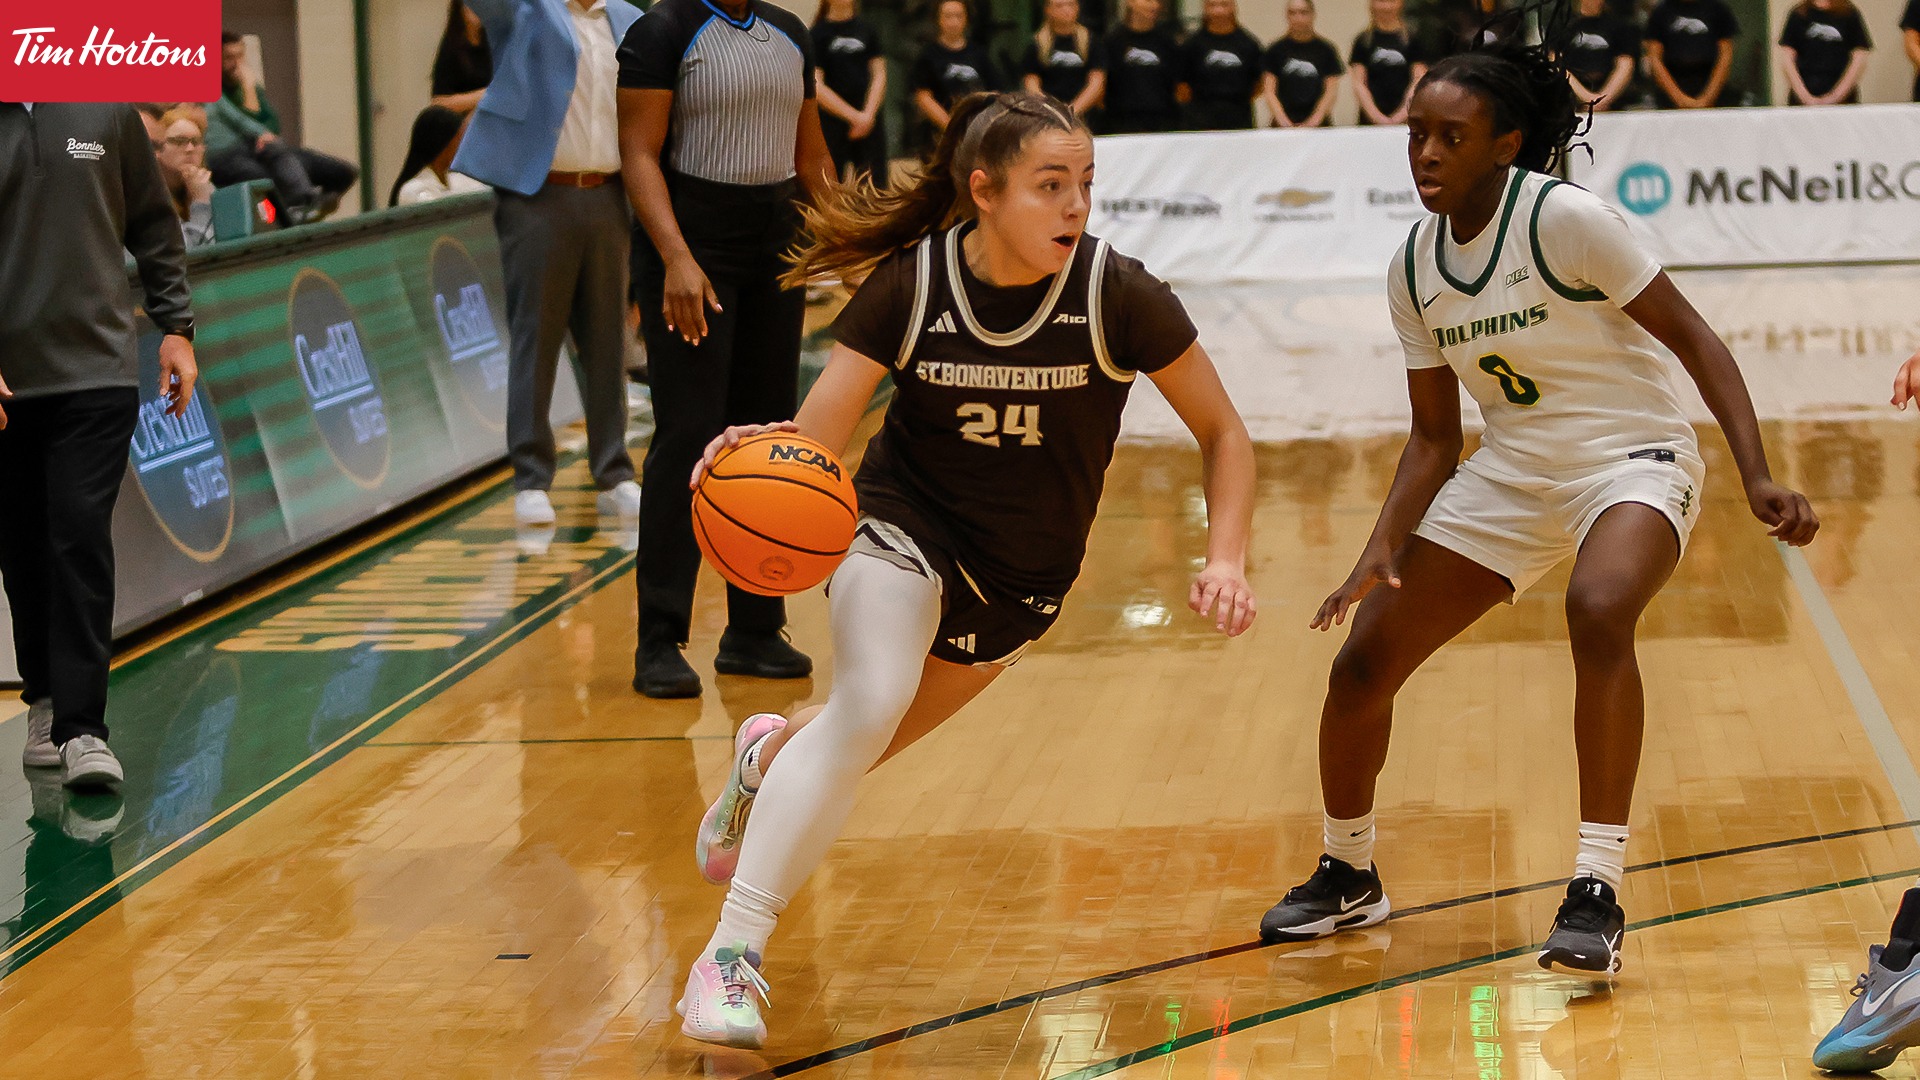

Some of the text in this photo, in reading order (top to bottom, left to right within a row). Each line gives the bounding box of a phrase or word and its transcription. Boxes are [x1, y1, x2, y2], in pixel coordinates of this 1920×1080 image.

[66, 137, 106, 155] Bonnies
[1505, 265, 1530, 286] NEC
[1432, 302, 1549, 350] DOLPHINS
[1477, 354, 1541, 406] 0
[956, 402, 1044, 448] 24
[768, 444, 842, 482] NCAA
